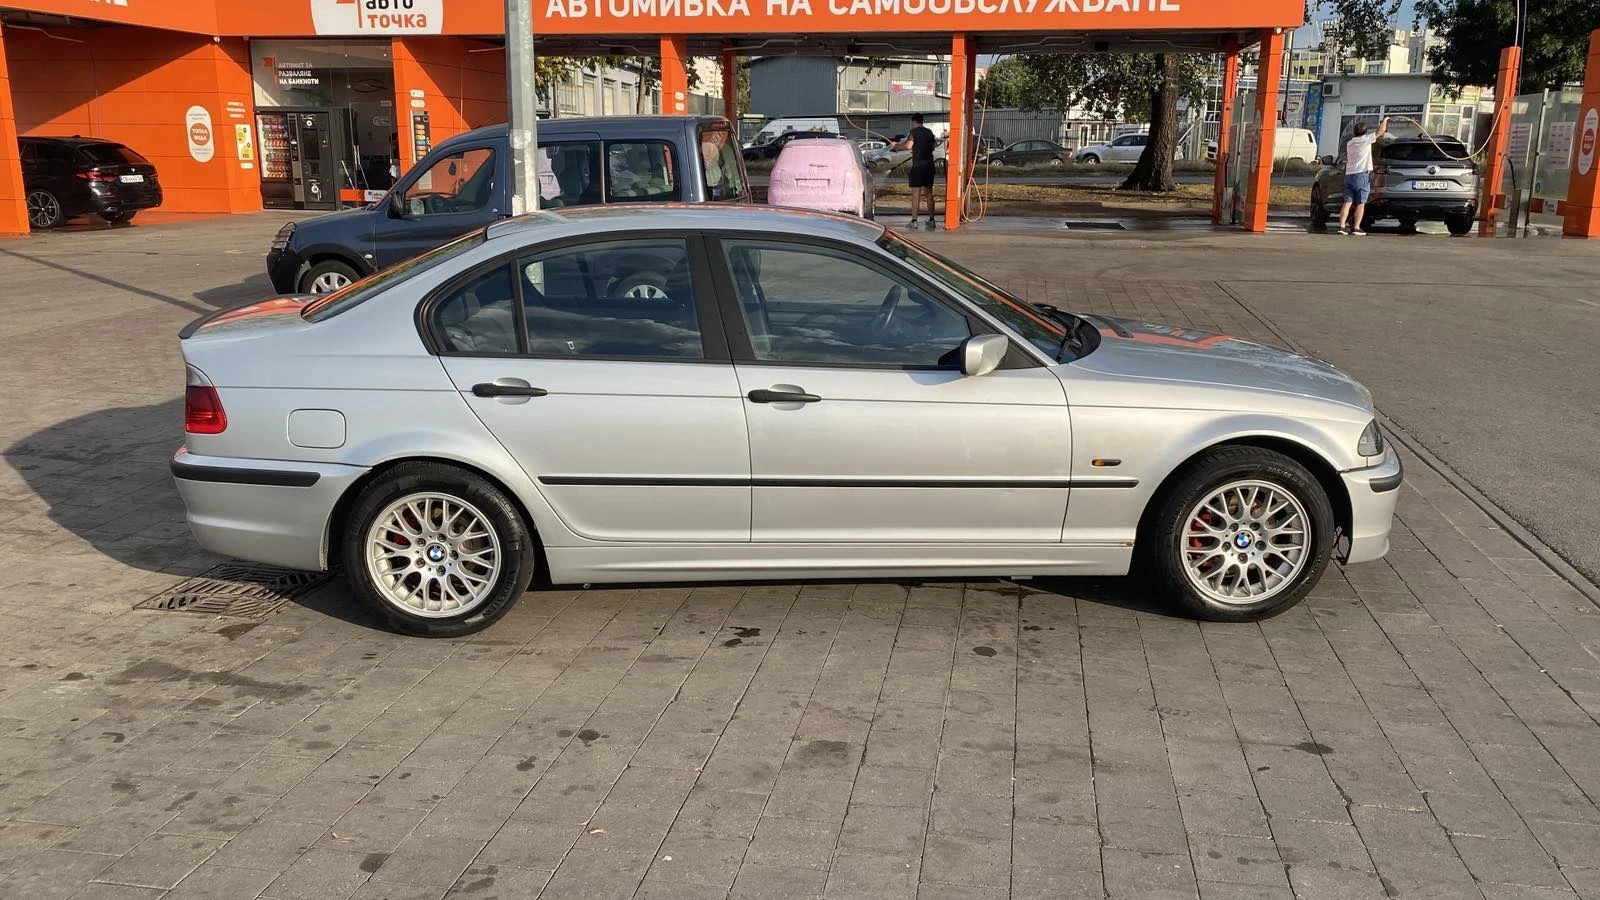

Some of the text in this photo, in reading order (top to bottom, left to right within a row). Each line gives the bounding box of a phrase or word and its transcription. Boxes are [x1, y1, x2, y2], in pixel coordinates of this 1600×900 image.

[365, 0, 414, 10] авто
[545, 0, 751, 18] АВТОМИВКА
[766, 0, 813, 16] НА
[366, 13, 428, 29] точка
